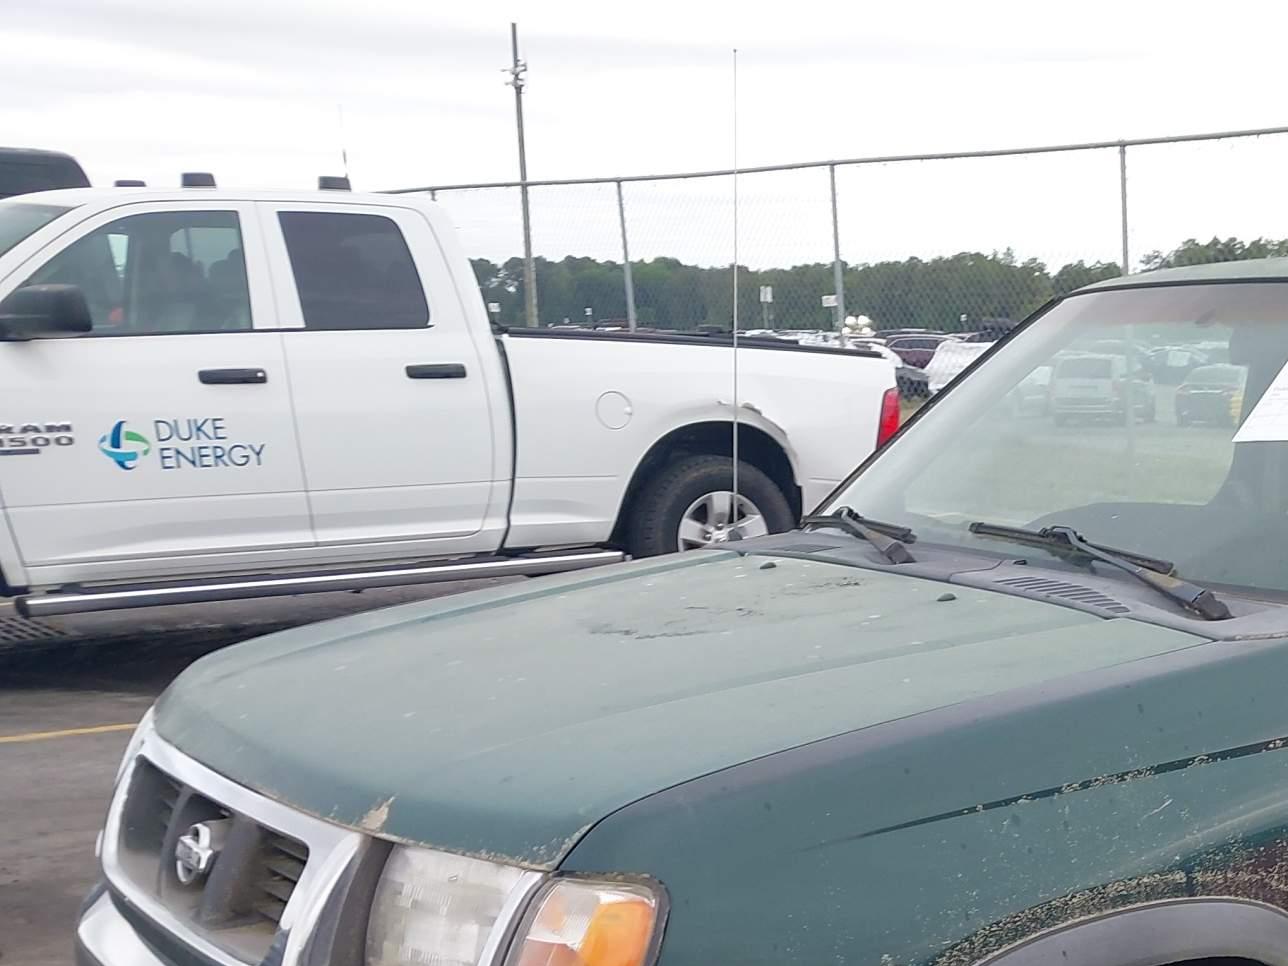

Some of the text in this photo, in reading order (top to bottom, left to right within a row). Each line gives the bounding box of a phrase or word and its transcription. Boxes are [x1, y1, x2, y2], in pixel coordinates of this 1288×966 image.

[0, 423, 72, 434] RAM
[153, 417, 229, 442] DUKE
[159, 444, 266, 470] ENERGY
